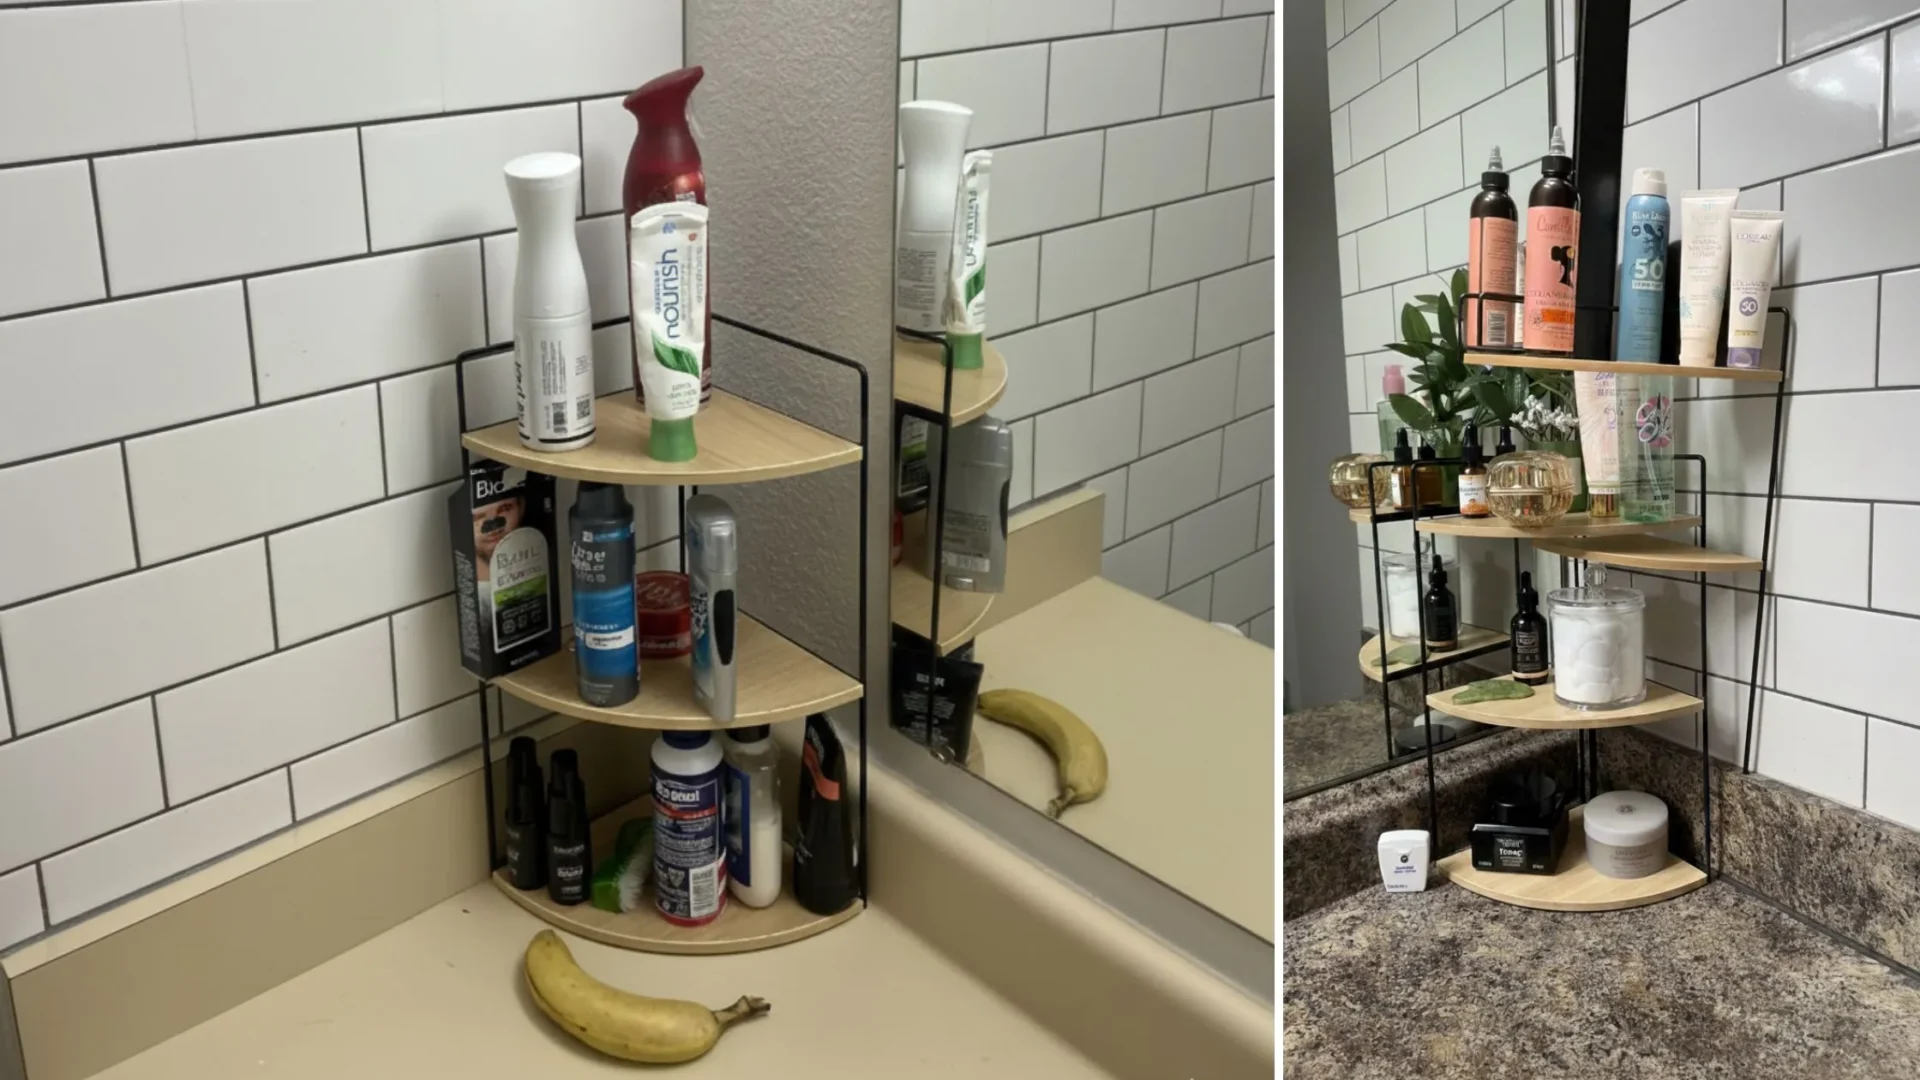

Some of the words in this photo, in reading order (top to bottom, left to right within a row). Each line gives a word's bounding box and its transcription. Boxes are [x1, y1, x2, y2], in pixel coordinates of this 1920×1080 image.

[1634, 258, 1664, 280] 50
[655, 247, 681, 339] nourish
[1741, 301, 1757, 312] 50
